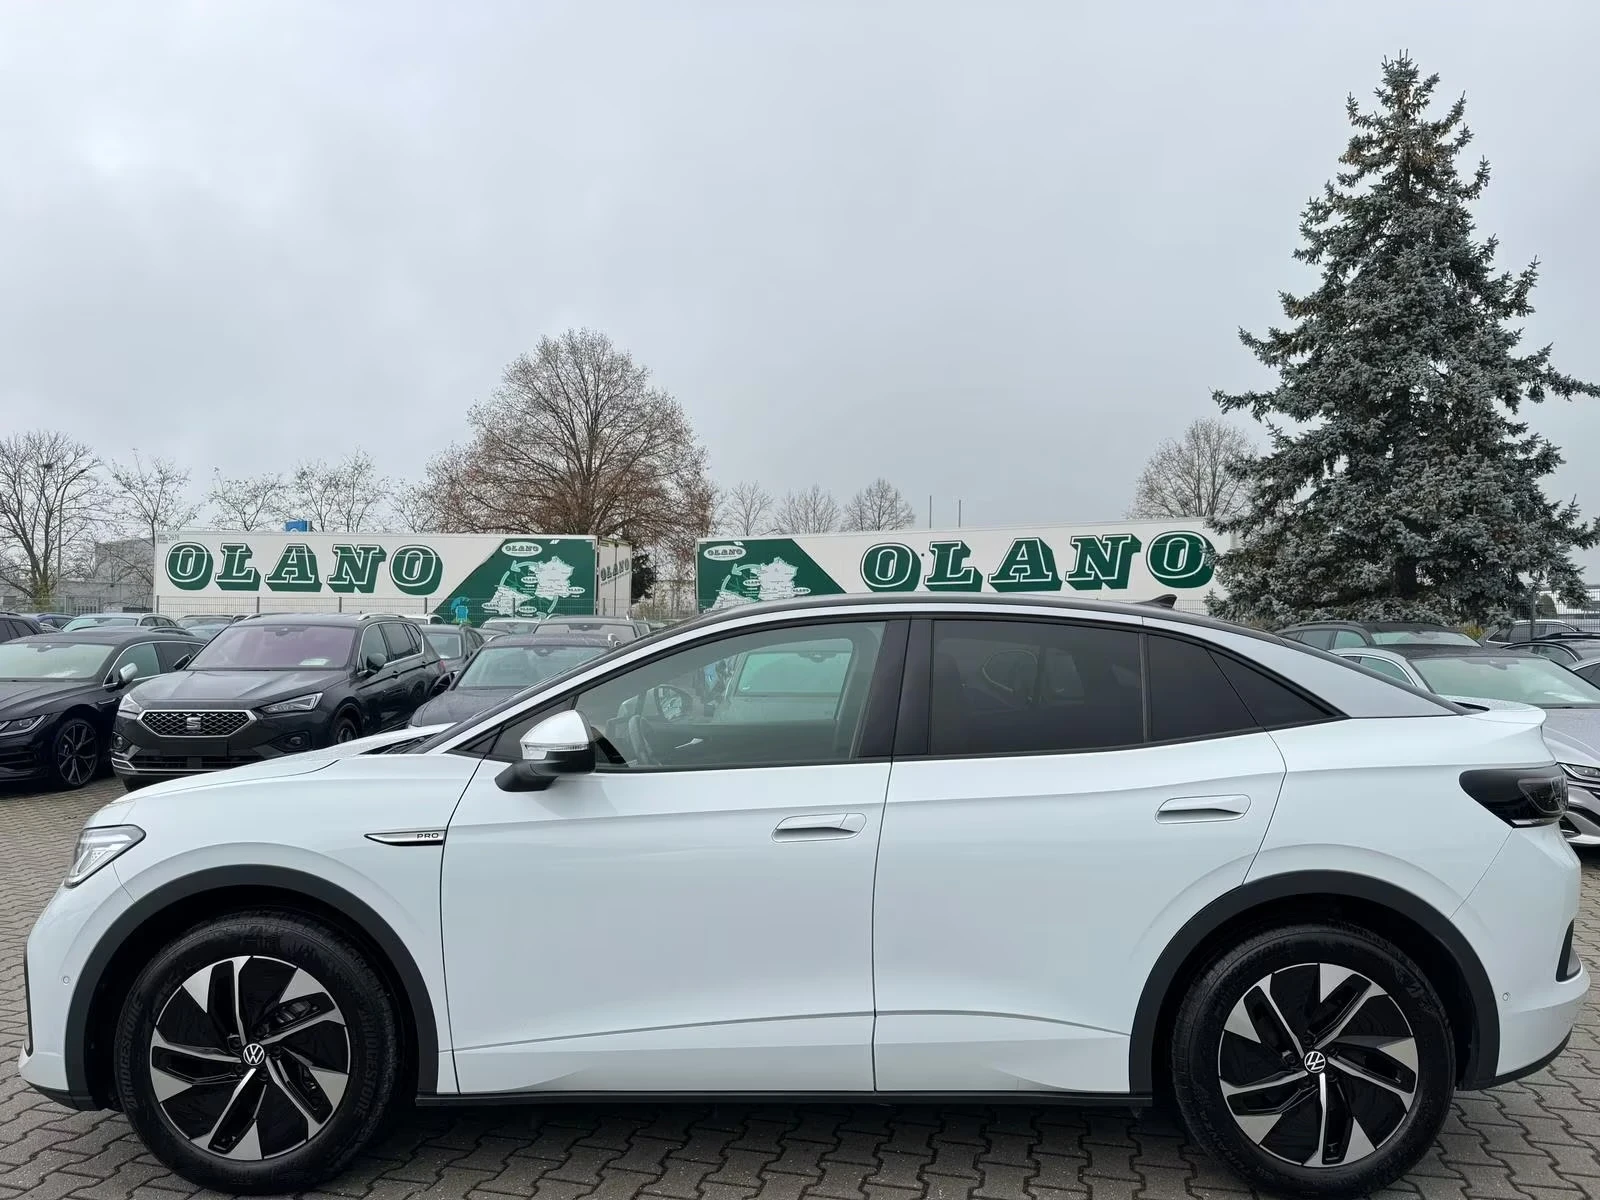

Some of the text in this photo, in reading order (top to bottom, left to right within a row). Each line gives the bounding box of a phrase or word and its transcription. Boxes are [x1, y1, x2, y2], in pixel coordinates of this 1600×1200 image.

[165, 541, 443, 596] OLANO
[600, 558, 630, 582] OLANO
[859, 530, 1216, 593] OLANO
